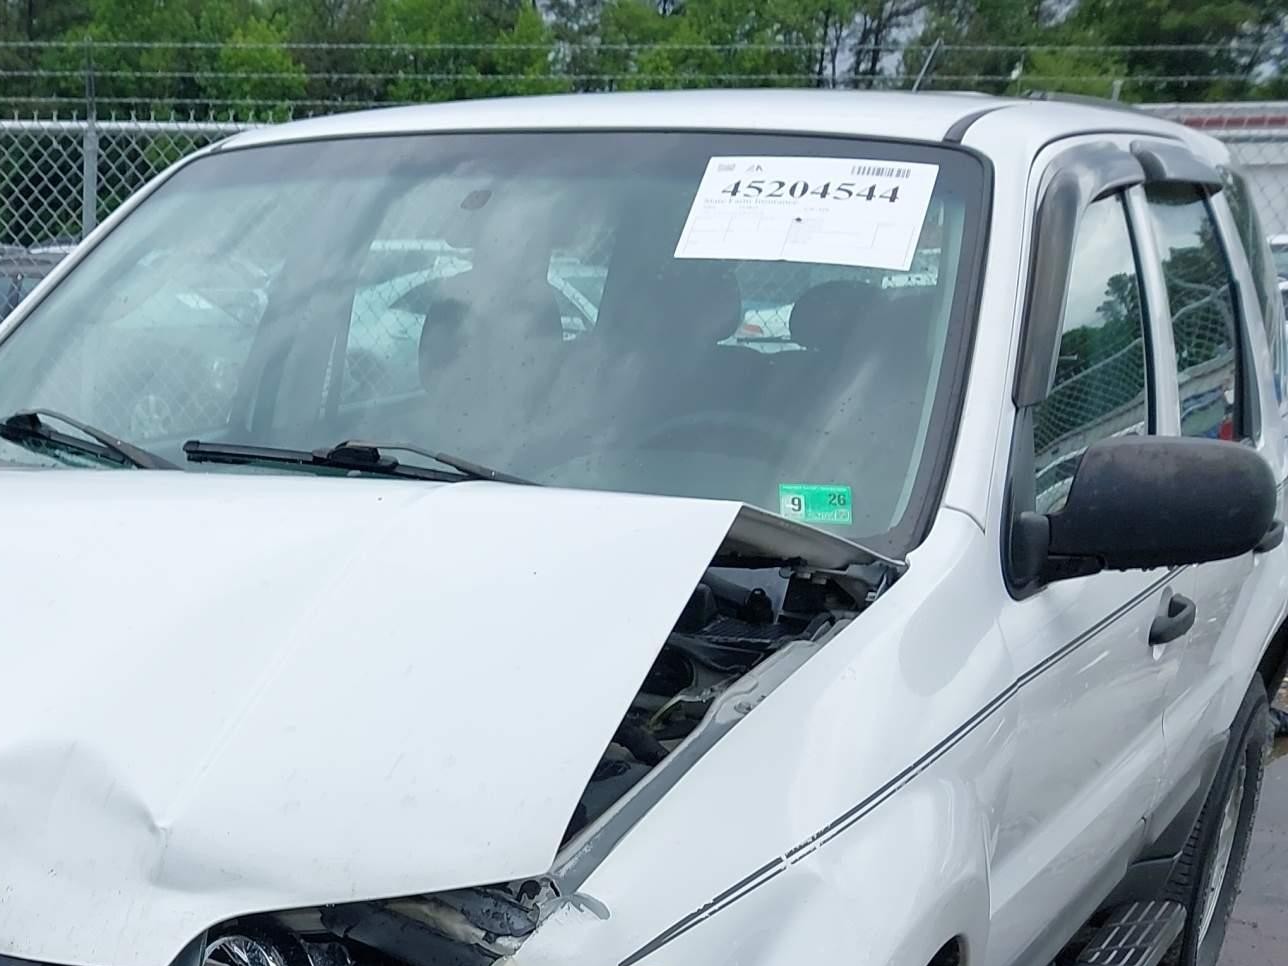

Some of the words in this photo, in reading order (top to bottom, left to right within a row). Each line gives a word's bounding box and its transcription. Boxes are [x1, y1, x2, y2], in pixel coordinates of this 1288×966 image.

[721, 179, 901, 204] 45204544
[791, 496, 802, 512] 9
[828, 493, 846, 506] 26
